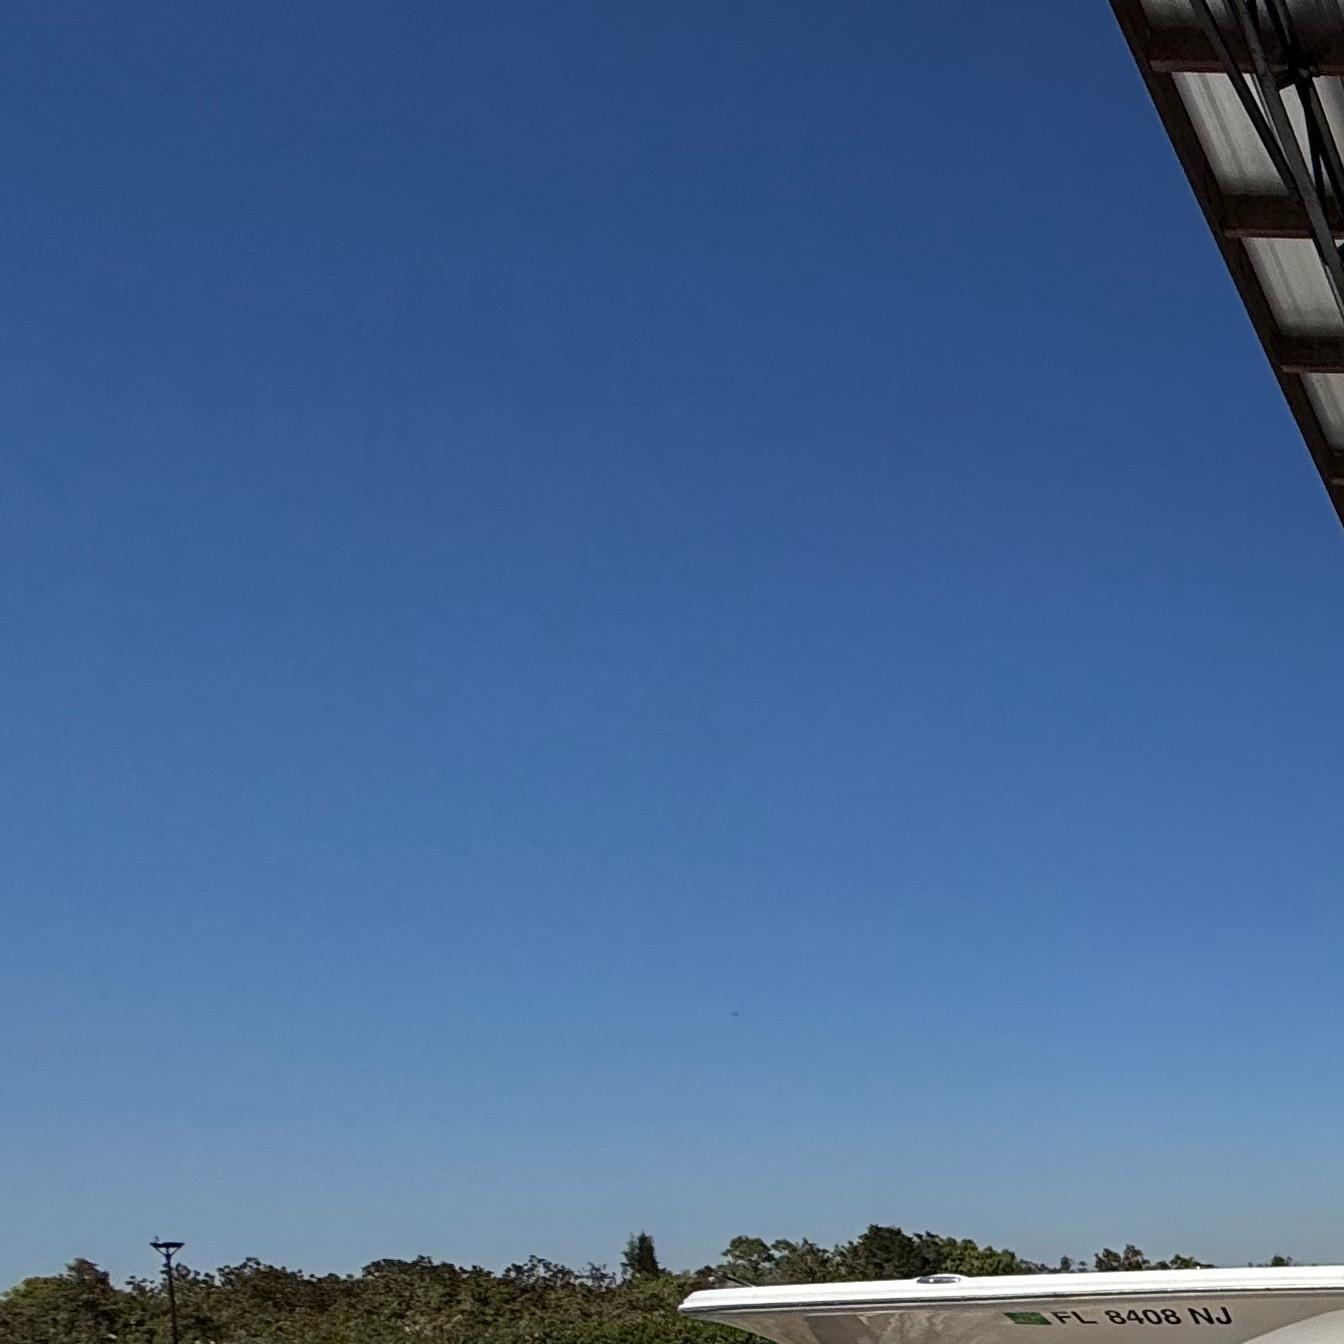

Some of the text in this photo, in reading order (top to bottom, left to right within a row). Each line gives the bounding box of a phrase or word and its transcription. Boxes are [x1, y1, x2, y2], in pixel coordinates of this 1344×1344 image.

[1051, 1306, 1233, 1326] FL 8408 NJ
